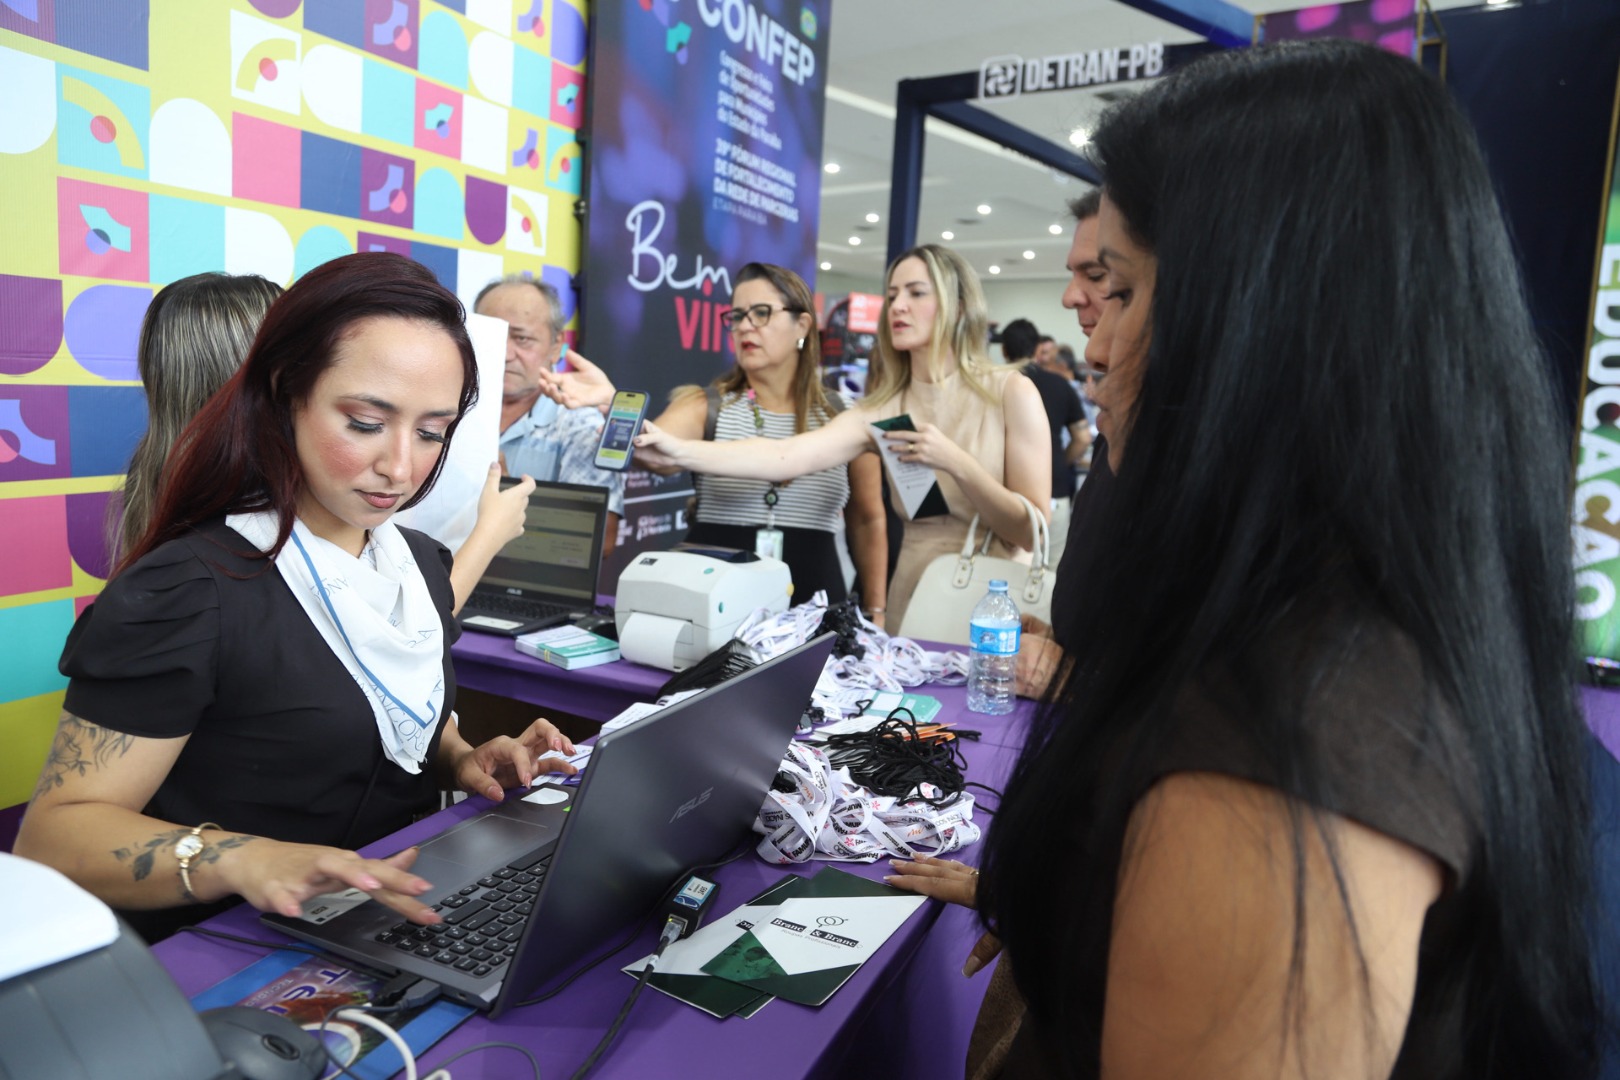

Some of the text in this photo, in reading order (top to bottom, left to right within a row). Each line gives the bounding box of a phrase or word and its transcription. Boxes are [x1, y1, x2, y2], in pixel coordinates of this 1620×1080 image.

[697, 0, 815, 86] CONFEP
[1024, 42, 1165, 92] DETRAN-PB
[625, 200, 733, 297] Bem
